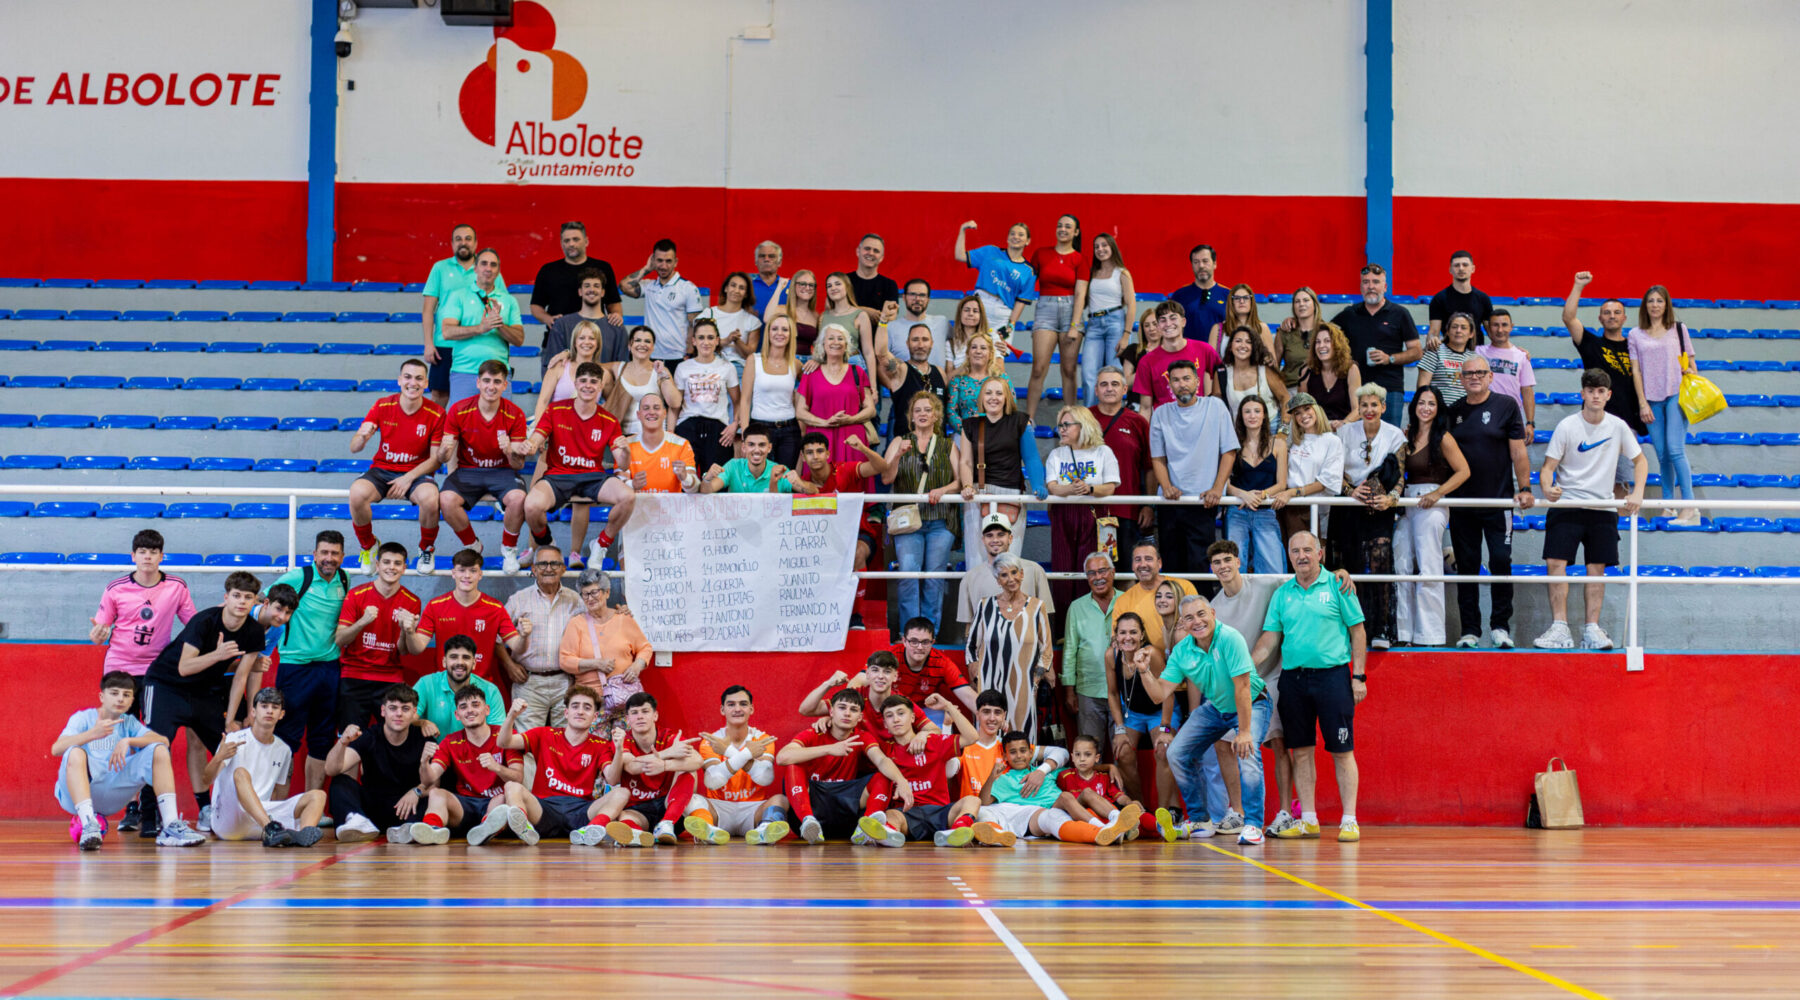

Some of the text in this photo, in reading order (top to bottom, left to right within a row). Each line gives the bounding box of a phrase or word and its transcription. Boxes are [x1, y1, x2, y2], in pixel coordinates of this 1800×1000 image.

[46, 72, 281, 107] ALBOLOTE
[505, 121, 643, 159] Albolote
[506, 161, 635, 180] ayuntamiento
[562, 454, 596, 468] pyltin
[1060, 460, 1096, 475] MORE
[795, 535, 828, 551] PARRA
[778, 556, 811, 569] MIGUEL
[778, 571, 820, 588] JUANITO
[779, 602, 827, 618] FERNANDO
[548, 778, 585, 796] pyltin
